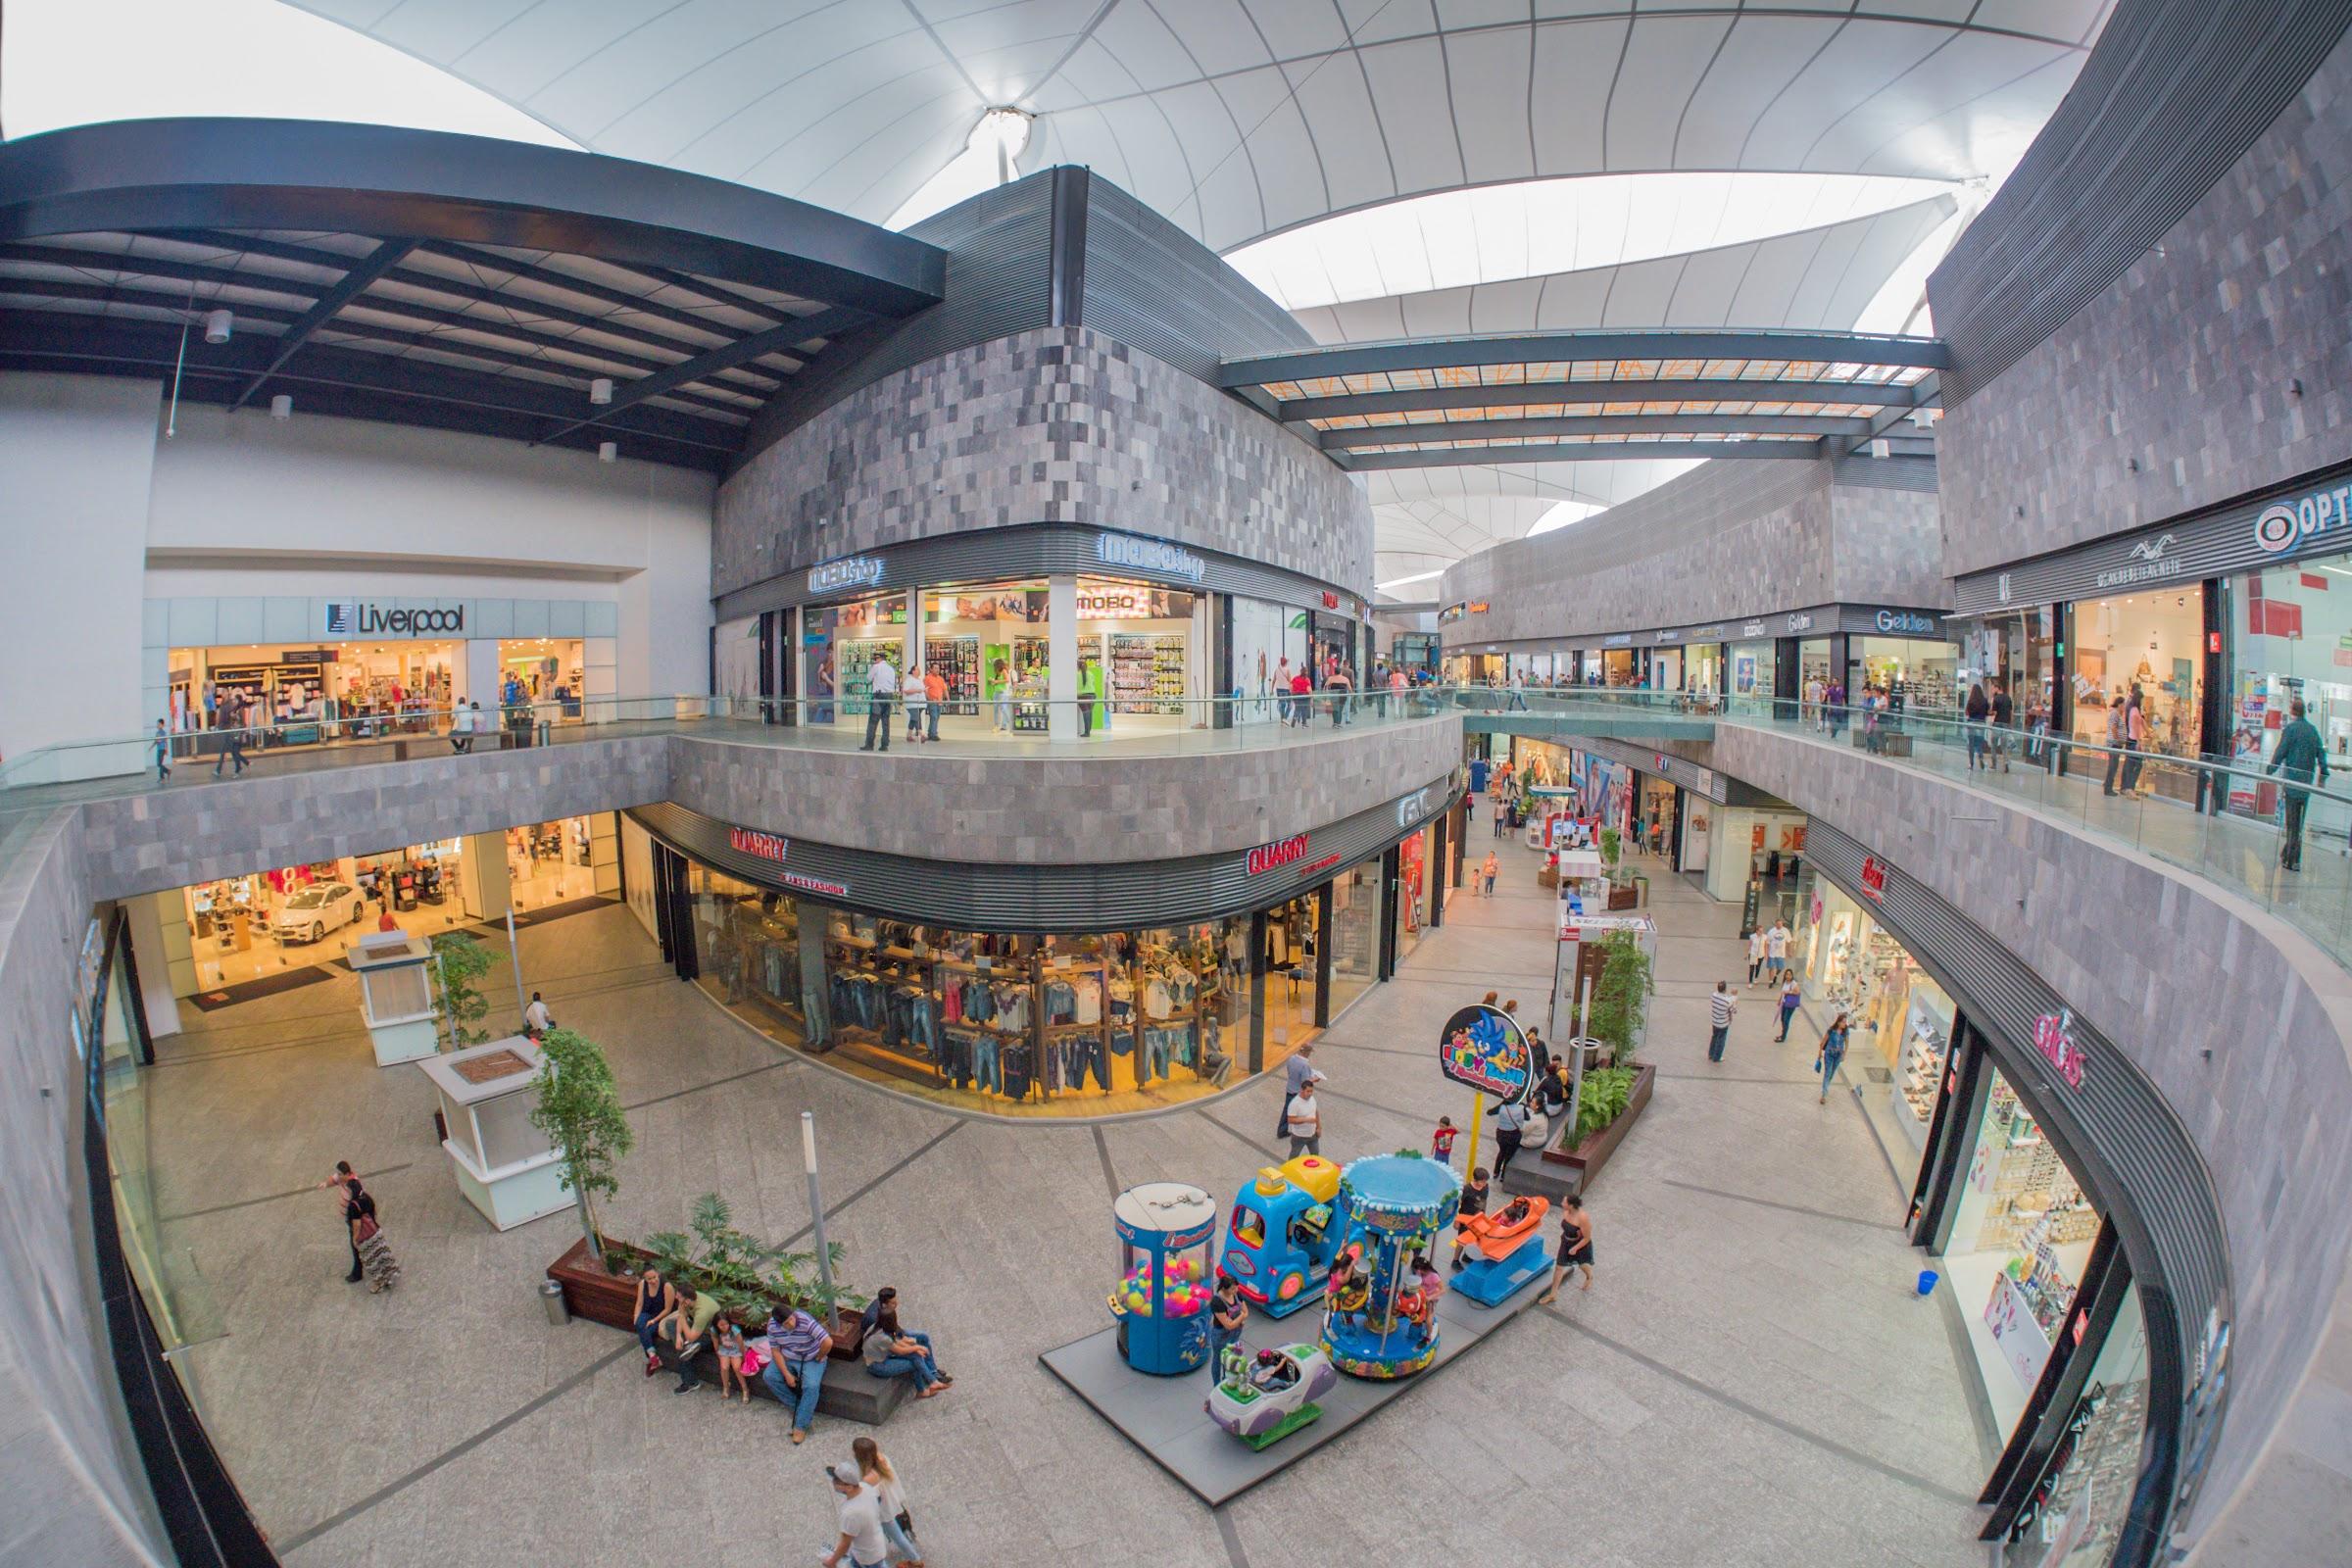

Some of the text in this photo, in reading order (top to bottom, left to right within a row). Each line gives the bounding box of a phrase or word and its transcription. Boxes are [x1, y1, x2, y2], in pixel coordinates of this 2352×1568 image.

[2299, 486, 2352, 535] OPT
[359, 604, 464, 637] Liverpool
[730, 827, 787, 862] QUARRY
[1249, 833, 1311, 875] QUARRY
